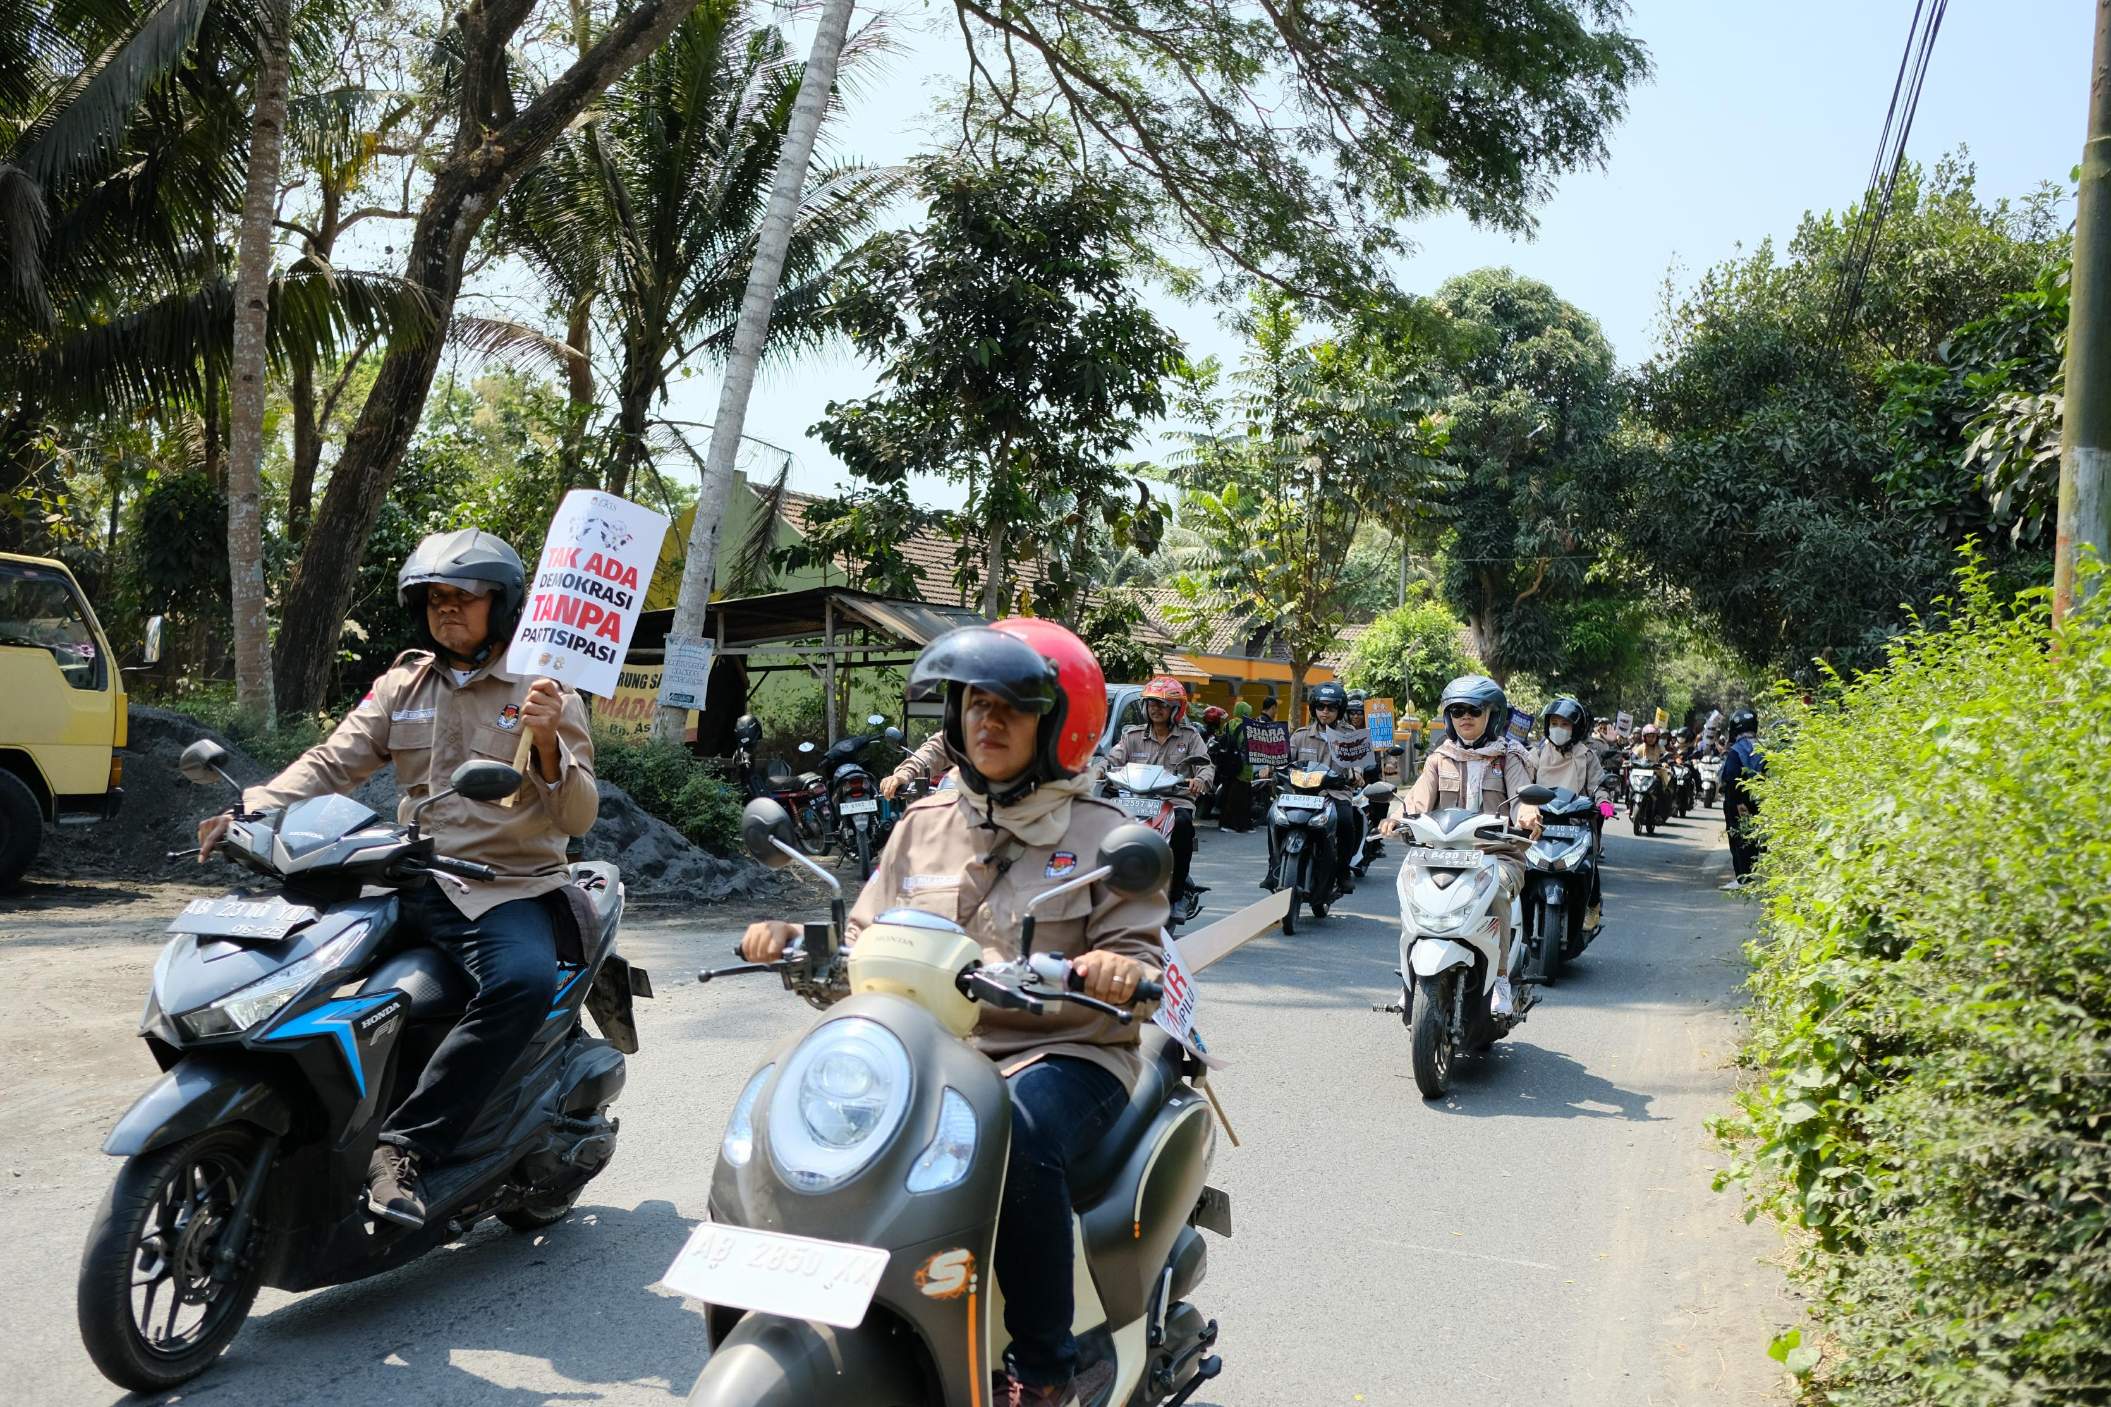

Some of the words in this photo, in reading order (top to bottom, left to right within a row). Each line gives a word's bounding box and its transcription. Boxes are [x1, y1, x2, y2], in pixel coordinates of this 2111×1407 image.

[547, 547, 583, 569] TAK
[583, 552, 638, 592] ADA
[540, 573, 634, 611] DEMOKRASI
[532, 594, 622, 644] TANPA
[521, 628, 617, 665] PARTISIPASI
[617, 671, 648, 689] RUNG
[1246, 726, 1285, 736] SUARA
[1247, 732, 1286, 743] PEMUDA
[1249, 757, 1288, 765] INDONESIA
[361, 1002, 401, 1029] HONDA
[745, 1240, 824, 1277] 2850
